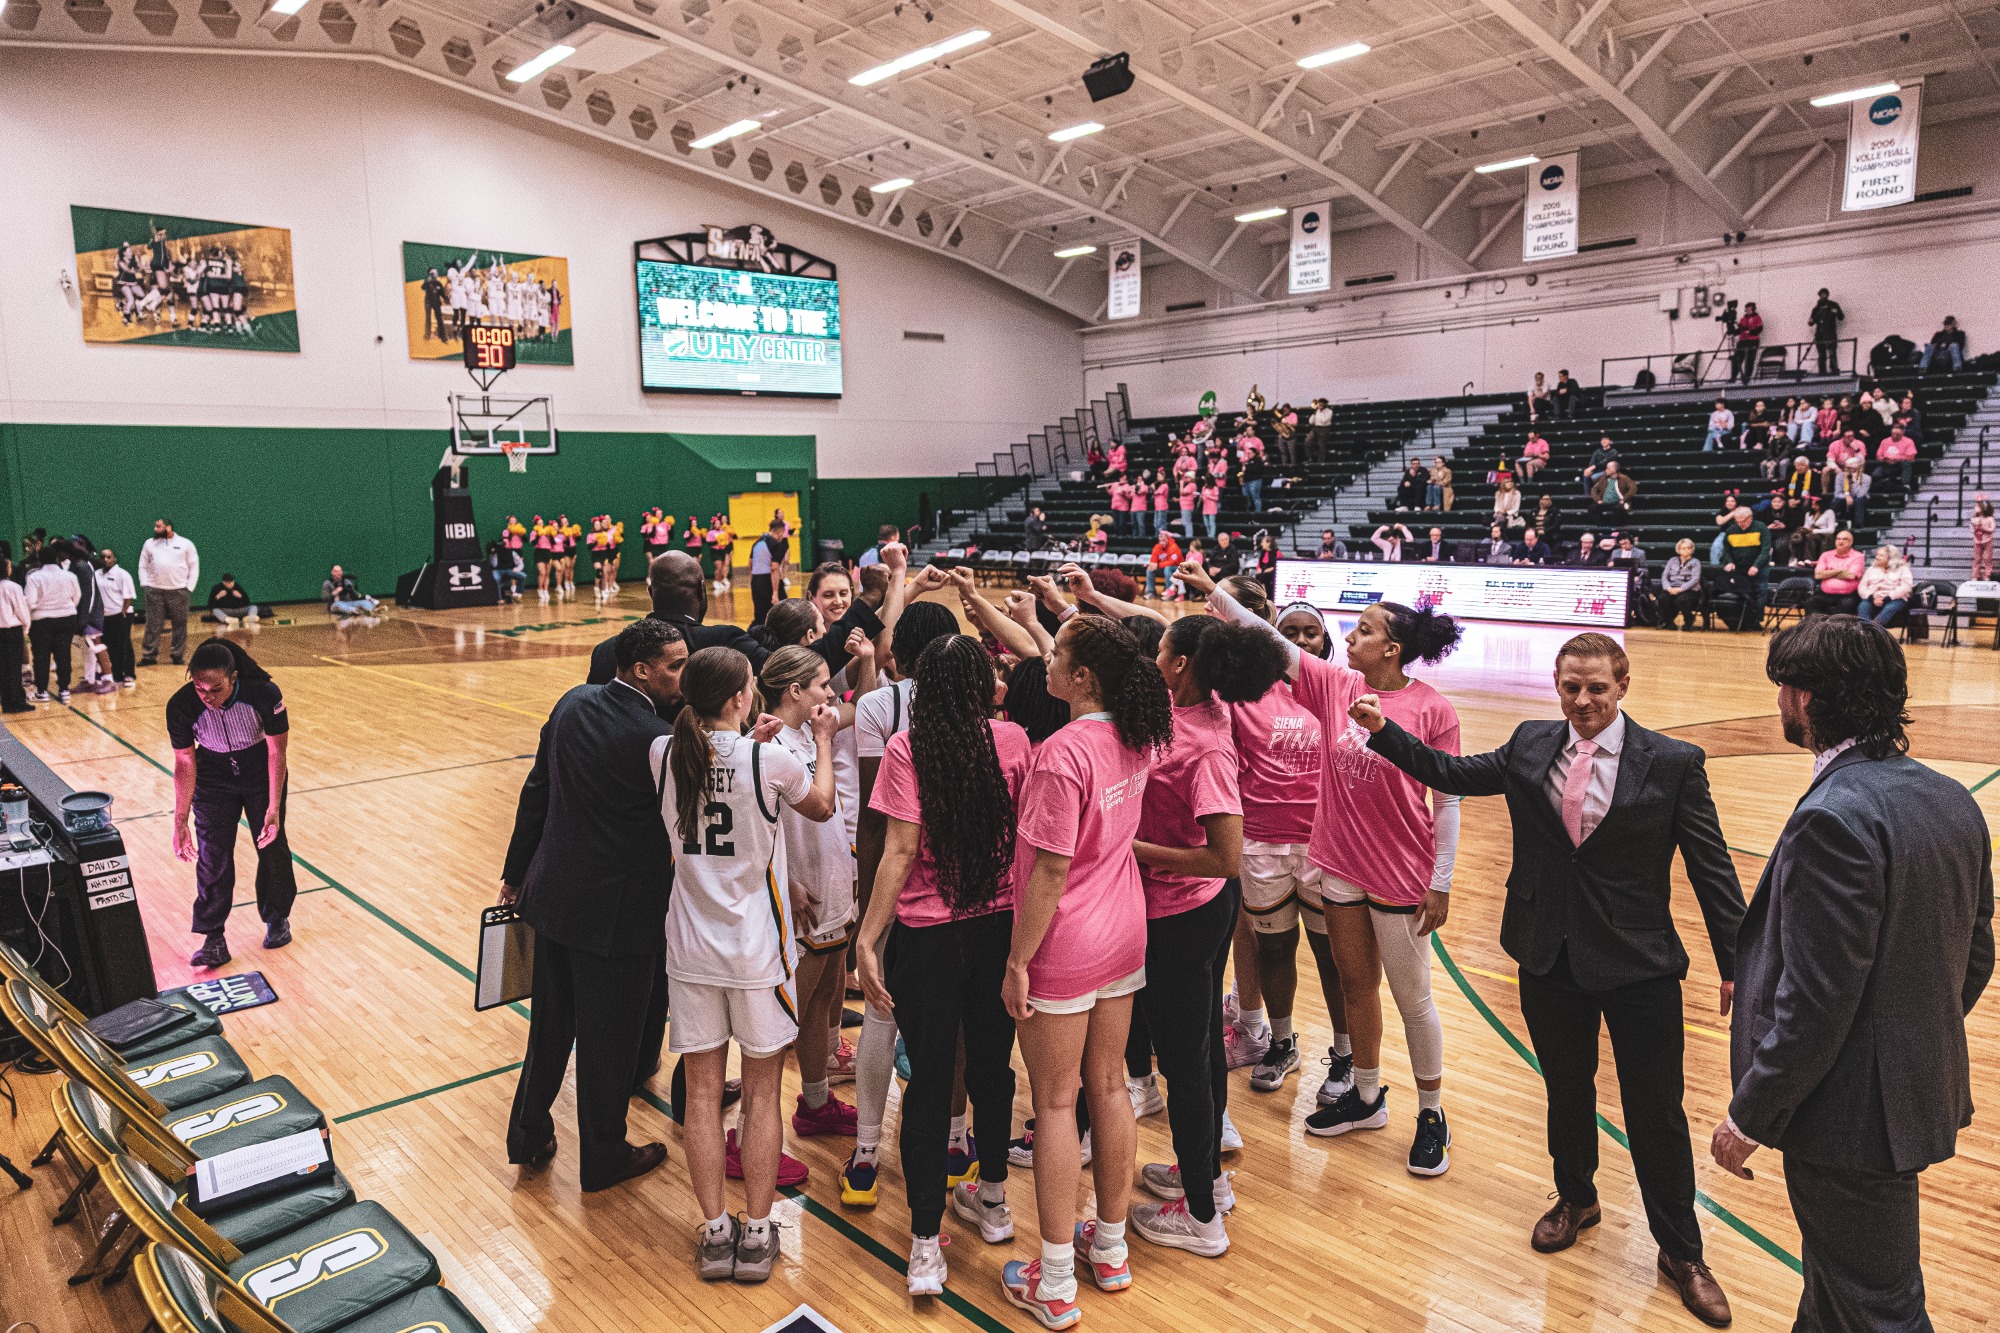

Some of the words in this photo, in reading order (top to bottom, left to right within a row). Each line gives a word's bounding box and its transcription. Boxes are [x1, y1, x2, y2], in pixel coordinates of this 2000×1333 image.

[1856, 148, 1909, 162] VOLLEYBALL
[1850, 157, 1912, 174] CHAMPIONSHIP
[1861, 175, 1899, 188] FIRST
[1856, 186, 1904, 199] ROUND
[1537, 232, 1564, 243] FIRST
[1533, 241, 1568, 252] ROUND
[656, 297, 759, 331] WELCOME
[760, 305, 788, 333] TO
[790, 308, 828, 336] THE
[471, 327, 513, 347] 10:00
[690, 331, 758, 361] UHY
[760, 336, 826, 365] CENTER
[477, 344, 504, 368] 30
[1273, 717, 1305, 730] SIENA
[1268, 730, 1322, 751] PINK
[1105, 779, 1129, 795] American
[1105, 788, 1124, 803] Cancer
[86, 860, 120, 874] DAVID
[95, 892, 131, 905] PASTOR
